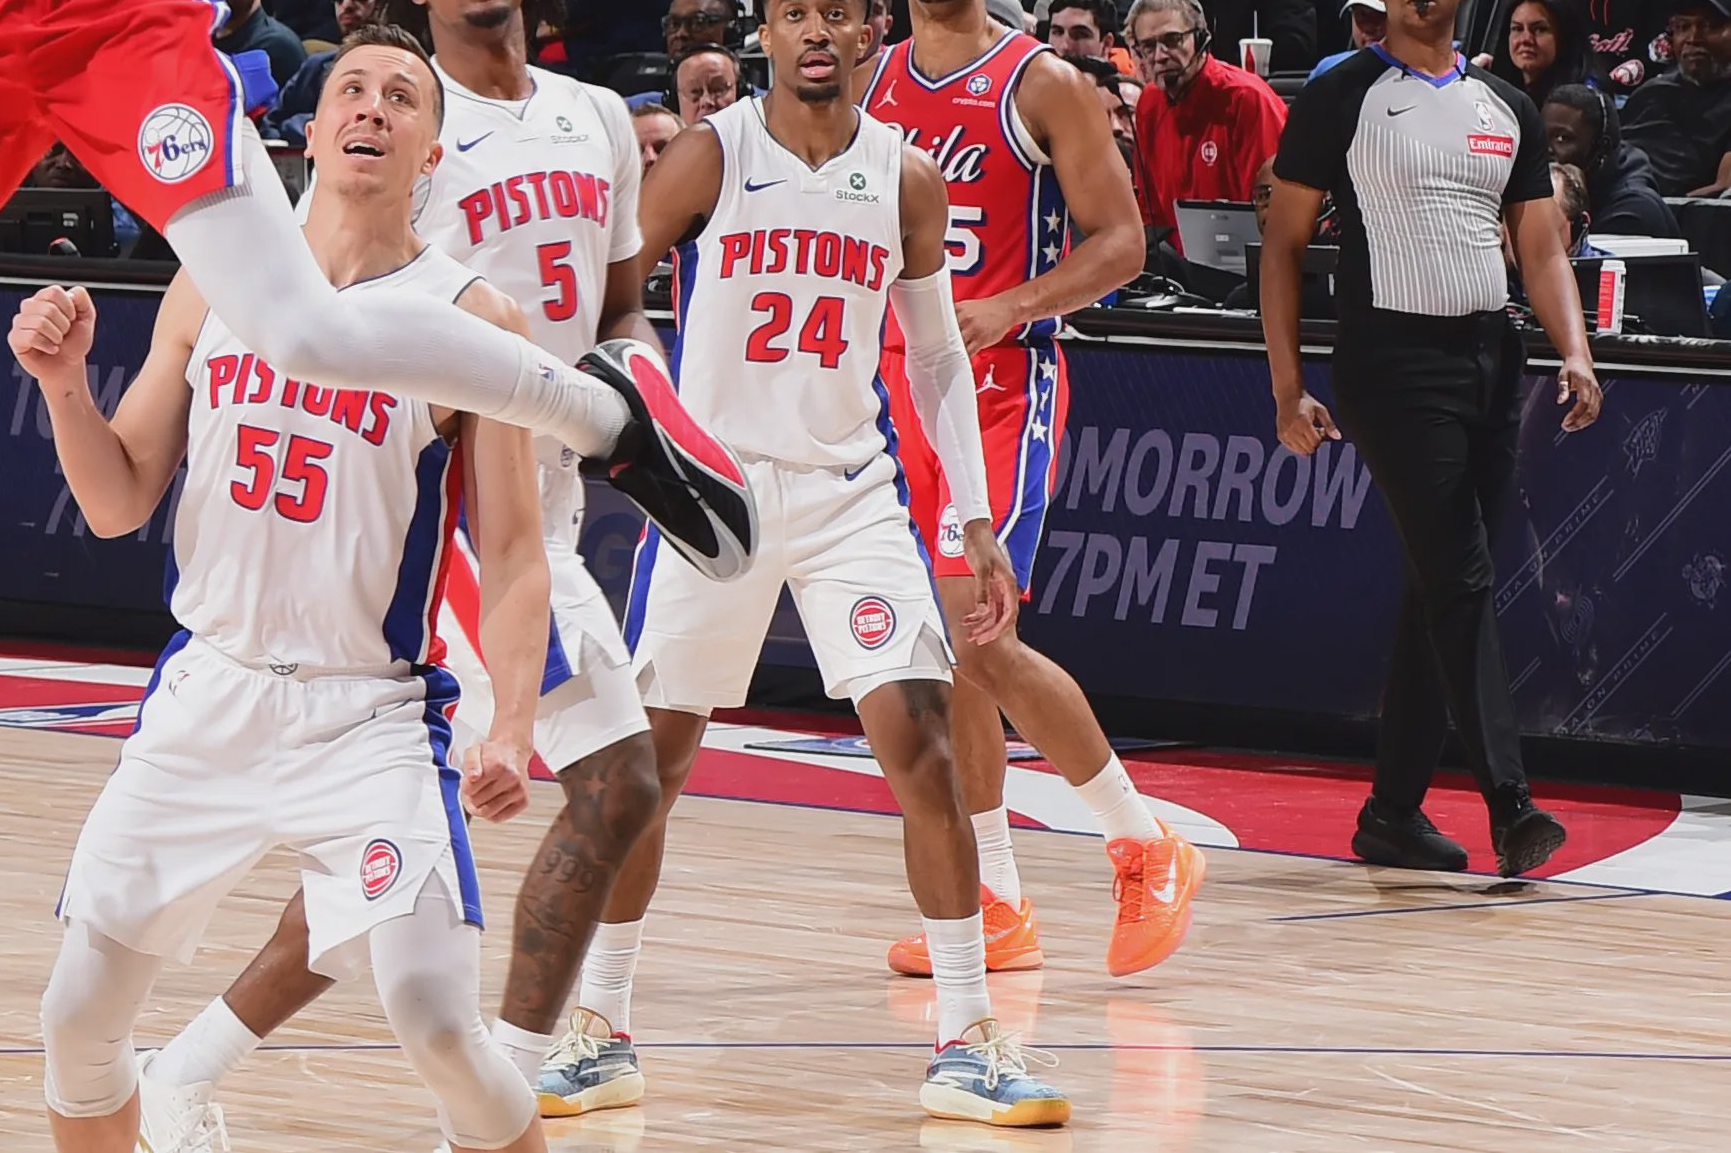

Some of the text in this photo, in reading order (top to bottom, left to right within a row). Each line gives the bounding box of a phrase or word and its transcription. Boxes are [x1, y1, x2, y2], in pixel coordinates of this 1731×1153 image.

[952, 97, 996, 109] crypto.com
[146, 133, 208, 171] 76ers
[1469, 137, 1513, 155] Emirates
[458, 170, 612, 246] PISTONS
[835, 189, 880, 204] StockX
[718, 228, 890, 292] PISTONS
[943, 206, 984, 274] 5
[536, 240, 578, 323] 5
[745, 291, 849, 370] 24
[230, 424, 333, 525] 55
[1039, 531, 1278, 632] 7PM ET
